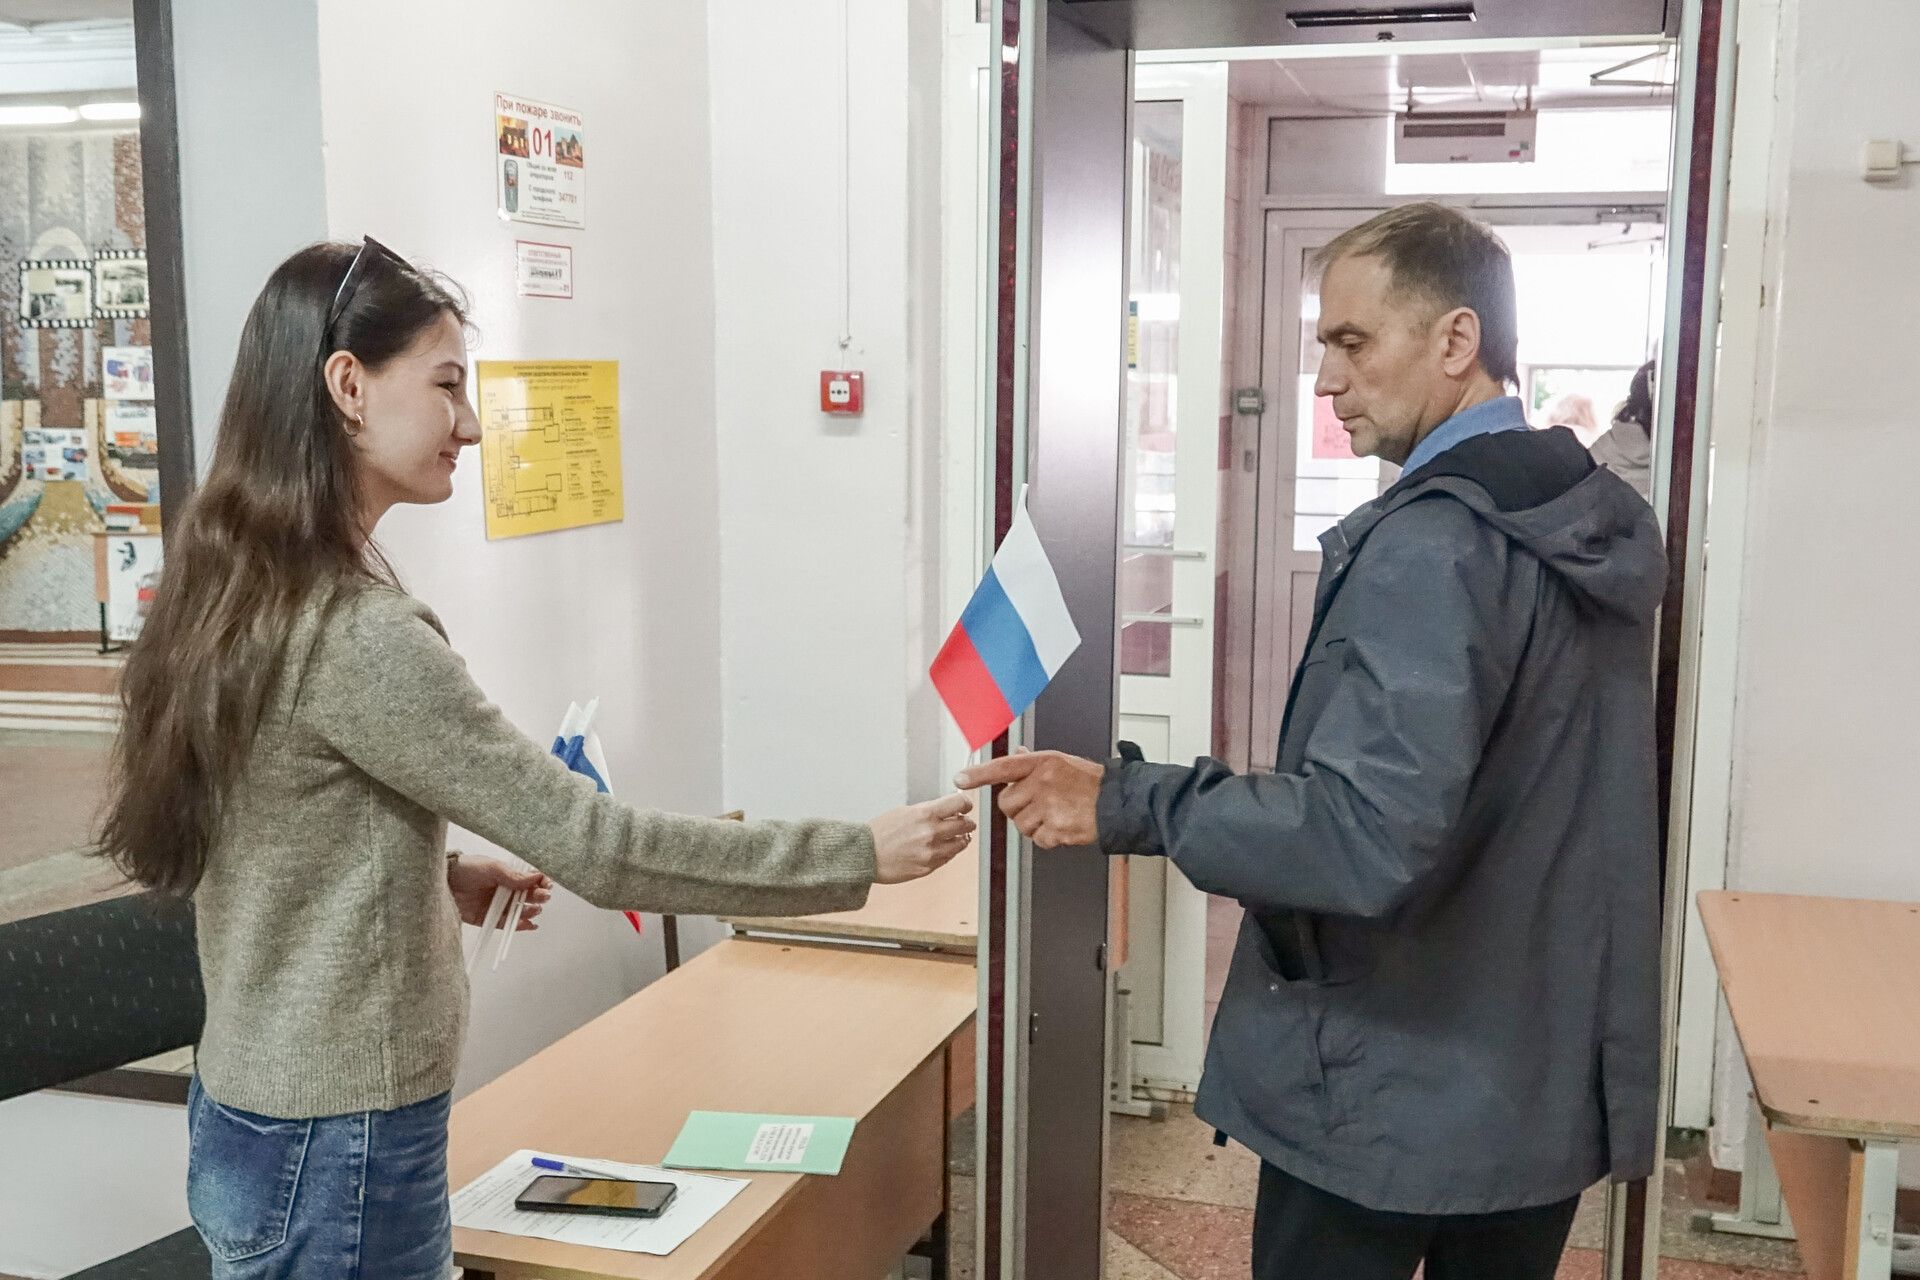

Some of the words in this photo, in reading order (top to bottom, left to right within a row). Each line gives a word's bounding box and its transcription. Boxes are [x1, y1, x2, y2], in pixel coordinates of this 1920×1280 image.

[496, 94, 513, 111] При
[515, 102, 548, 119] пожаре
[550, 109, 582, 127] звонить
[532, 127, 552, 158] 01
